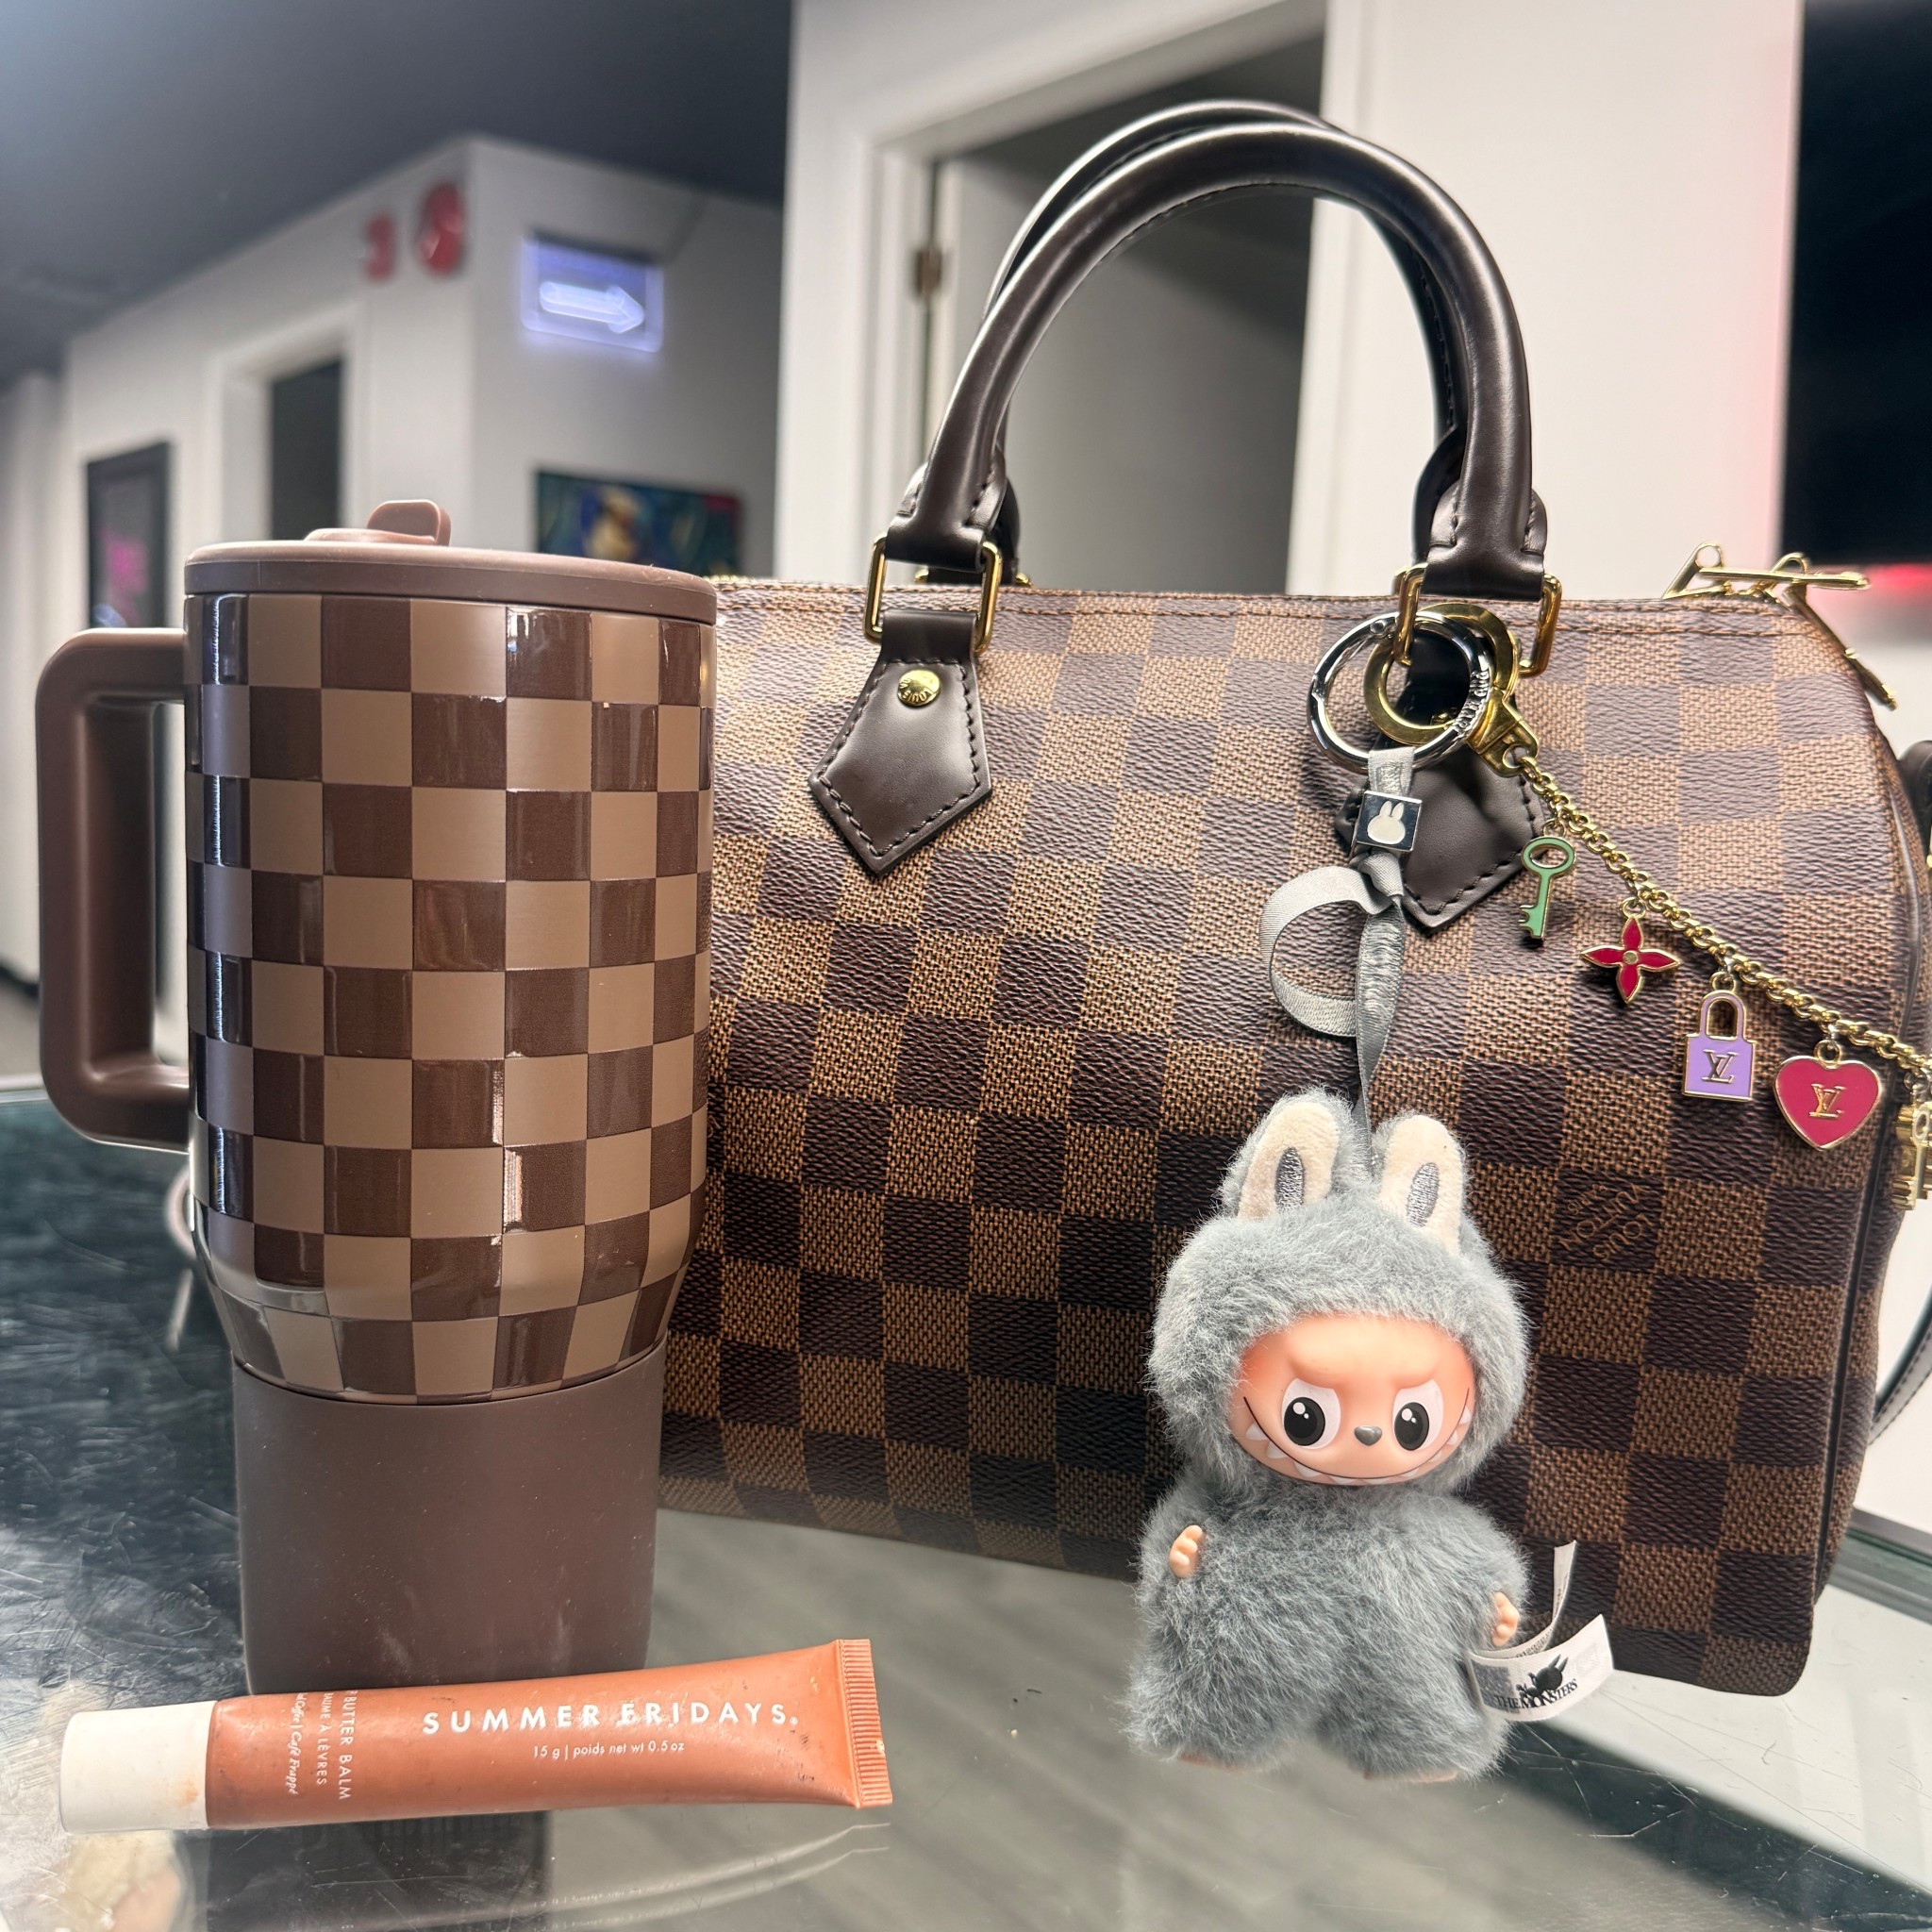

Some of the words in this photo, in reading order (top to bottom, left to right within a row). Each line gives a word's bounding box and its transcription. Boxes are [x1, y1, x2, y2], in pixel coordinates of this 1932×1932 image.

[320, 1692, 334, 1720] BAUME
[1493, 1694, 1520, 1709] THE
[1520, 1678, 1578, 1709] MONSTERS
[291, 1699, 306, 1723] Coffee
[340, 1696, 358, 1745] BUTTER
[422, 1705, 601, 1735] SUMMER
[319, 1724, 333, 1733] À
[316, 1738, 331, 1786] LÈVRES
[533, 1745, 548, 1758] 15
[552, 1746, 560, 1760] g
[573, 1741, 605, 1759] poids
[608, 1742, 627, 1756] net
[631, 1741, 644, 1754] wt
[647, 1740, 668, 1753] 0.5
[670, 1741, 685, 1752] oz
[285, 1757, 300, 1795] Frappé
[339, 1754, 353, 1800] BALM
